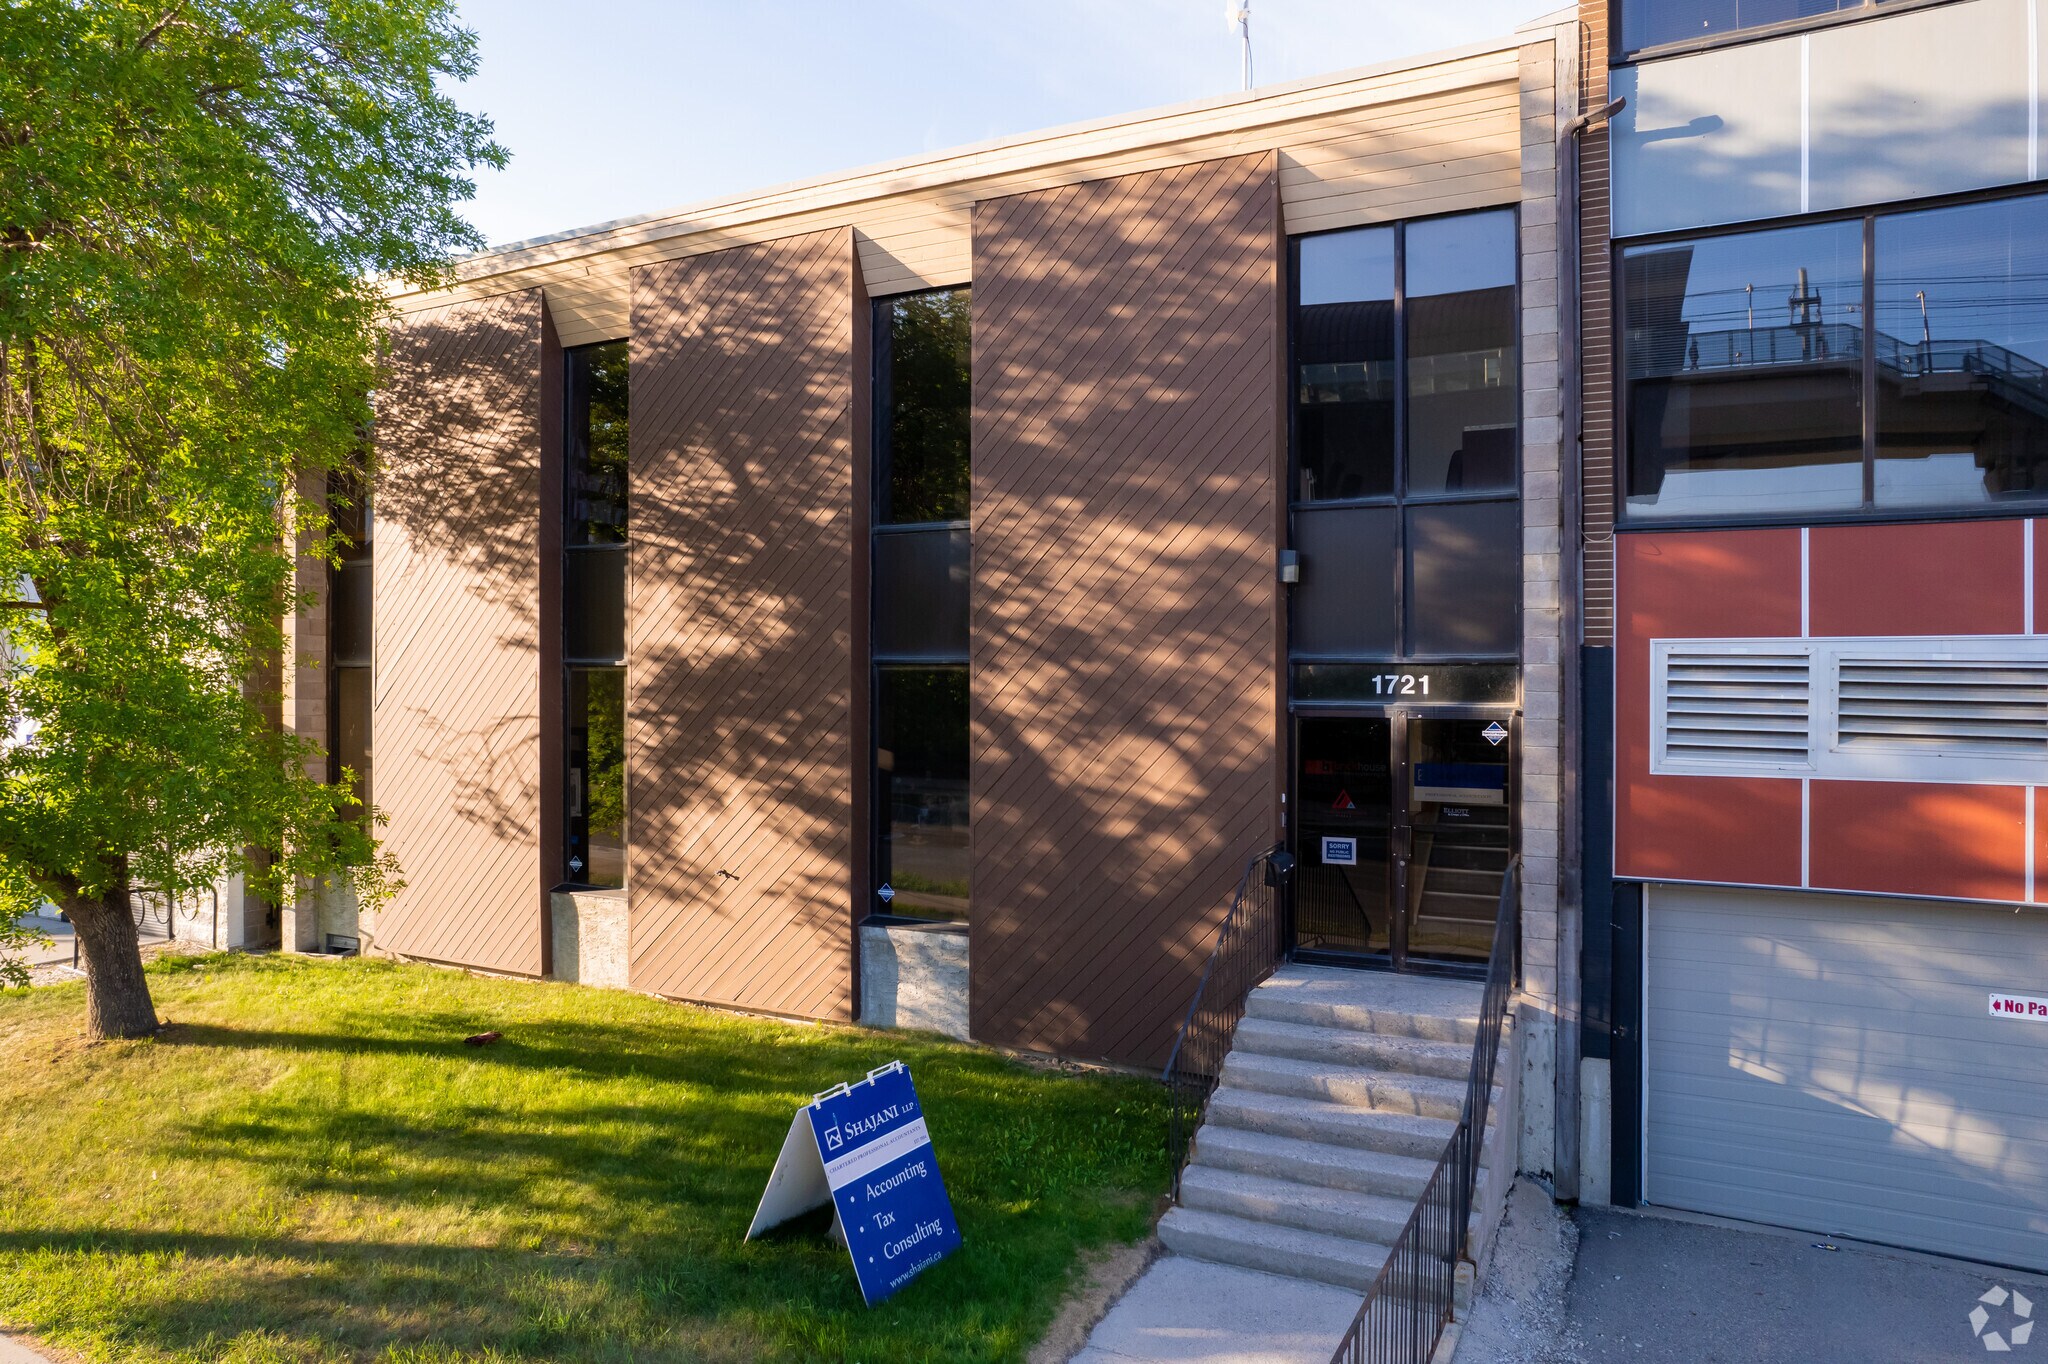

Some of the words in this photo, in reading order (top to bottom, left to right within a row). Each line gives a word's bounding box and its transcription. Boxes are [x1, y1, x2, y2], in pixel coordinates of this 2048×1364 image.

[1371, 674, 1429, 695] 1721
[1328, 842, 1350, 850] SORRY
[2004, 999, 2024, 1014] No
[2028, 1001, 2048, 1016] Pa
[901, 1101, 915, 1114] LLP
[829, 1157, 857, 1174] CHARTERED
[857, 1141, 889, 1160] PROFESSIONAL
[890, 1125, 921, 1144] ACCOUNTANTS
[866, 1159, 928, 1202] Accounting
[873, 1210, 896, 1230] Tax
[883, 1218, 943, 1260] Consulting
[889, 1250, 942, 1289] www.shajani.ca
